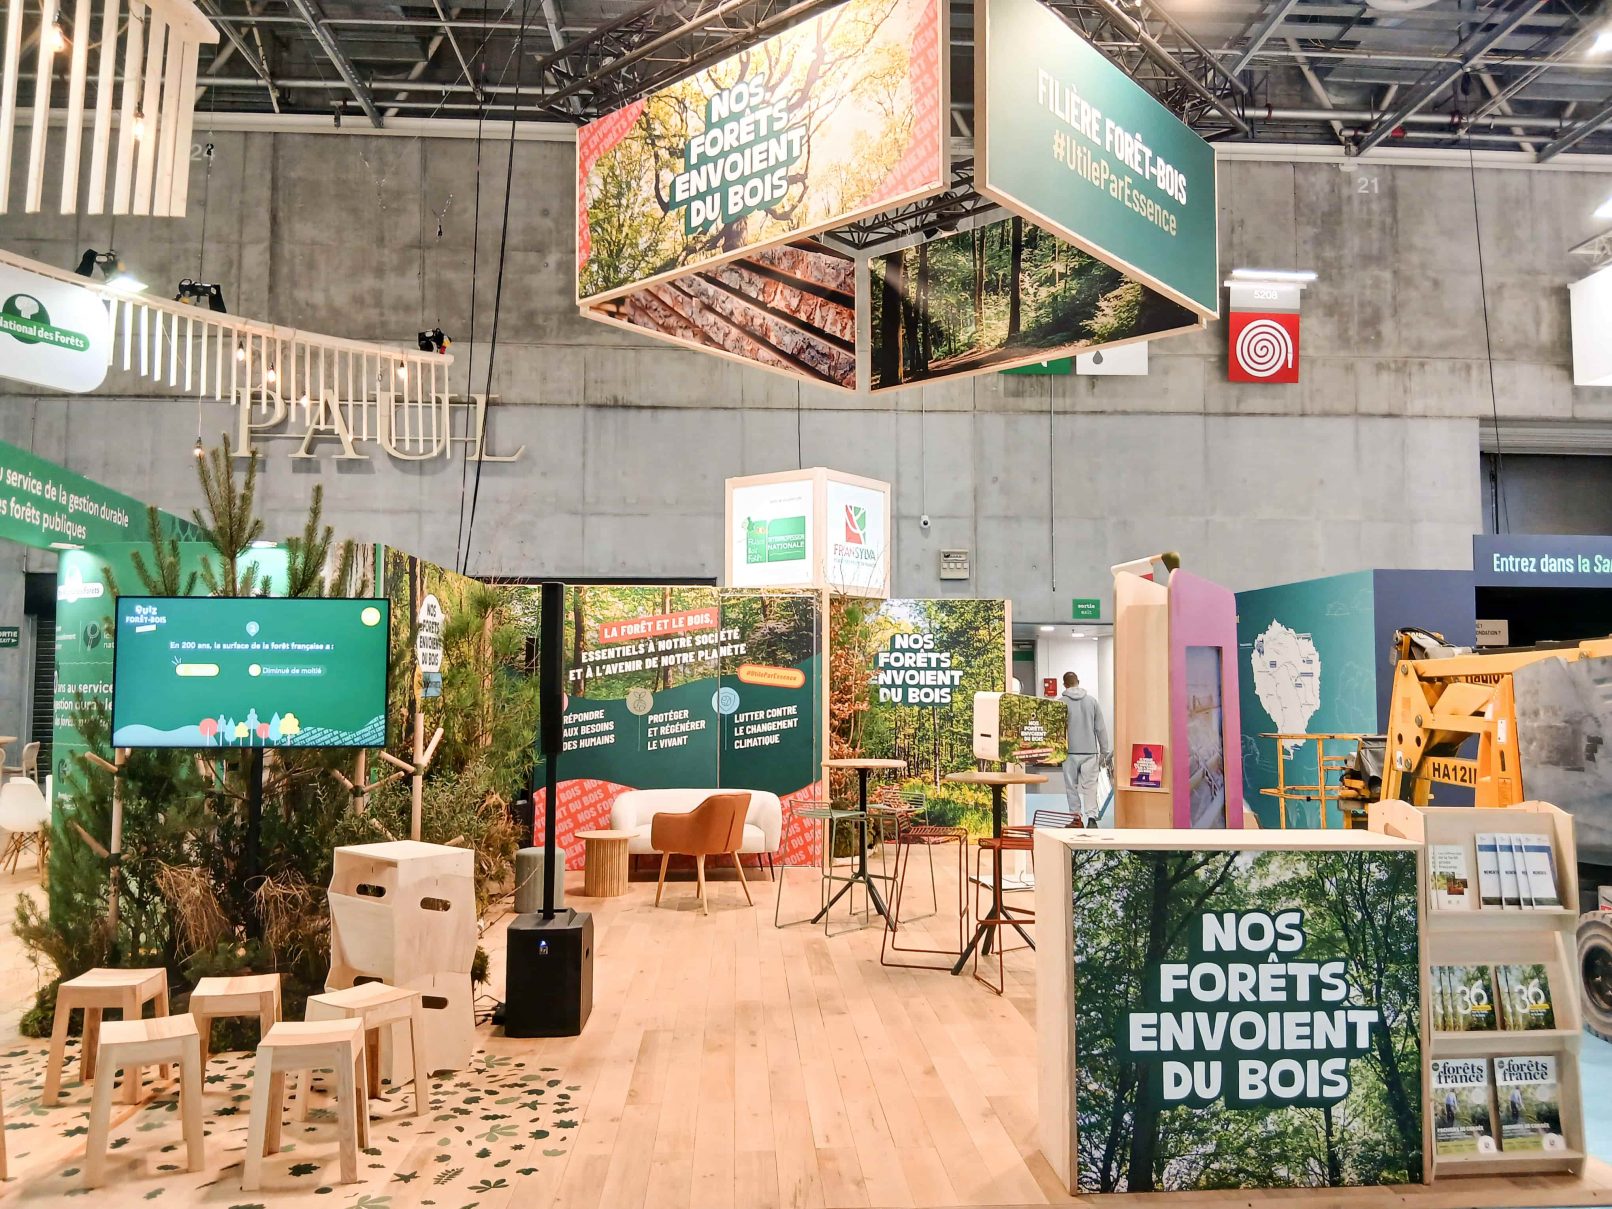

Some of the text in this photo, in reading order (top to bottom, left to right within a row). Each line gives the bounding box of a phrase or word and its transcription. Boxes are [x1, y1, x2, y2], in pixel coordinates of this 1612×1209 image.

[711, 75, 765, 124] NOS
[690, 104, 789, 165] FORÊTS
[1038, 67, 1187, 205] FILIÈRE FORÊT-BOIS
[676, 127, 807, 203] ENVOIENT
[1053, 129, 1177, 236] #UtileParEssence
[1357, 178, 1380, 195] 21
[691, 174, 789, 229] DU BOIS
[37, 327, 54, 341] des
[55, 331, 85, 348] Forêts
[230, 387, 526, 462] PAUL
[6, 468, 42, 495] service
[45, 479, 57, 501] de
[59, 484, 67, 505] la
[68, 494, 99, 517] gestion
[100, 502, 129, 528] durable
[10, 496, 41, 525] forêts
[42, 511, 87, 541] publiques
[833, 543, 876, 561] FRANSYLVA
[1493, 553, 1537, 573] Entrez
[1541, 554, 1575, 573] dans
[1578, 554, 1590, 573] la
[427, 603, 437, 618] NOS
[604, 612, 714, 639] LA FORÊT ET LE BOIS,
[170, 641, 180, 650] En
[181, 641, 196, 650] 200
[197, 642, 212, 651] ans,
[213, 641, 220, 650] la
[222, 641, 249, 651] surface
[250, 641, 260, 650] de
[262, 641, 269, 650] la
[270, 641, 290, 650] forêt
[290, 642, 324, 652] française
[581, 628, 740, 663] ESSENTIELS À NOTRE SOCIÉTÉ
[894, 633, 935, 650] NOS
[422, 652, 439, 667] DU BOIS
[569, 669, 584, 681] ET
[585, 666, 595, 679] À
[645, 657, 658, 669] DE
[660, 651, 696, 667] NOTRE
[697, 643, 747, 661] PLANÈTE
[878, 648, 952, 668] FORÊTS
[262, 666, 322, 675] Diminué de moitié
[67, 683, 77, 693] au
[879, 687, 952, 704] DU BOIS
[563, 709, 605, 725] RÉPONDRE
[648, 709, 690, 724] PROTÉGER
[734, 705, 798, 723] LUTTER CONTRE
[563, 721, 615, 738] AUX BESOINS
[647, 719, 706, 737] ET RÉGÉNÉRER
[734, 718, 799, 737] LE CHANGEMENT
[563, 734, 615, 752] DES HUMAINS
[647, 735, 689, 751] LE VIVANT
[734, 734, 780, 749] CLIMATIQUE
[1201, 911, 1304, 952] NOS
[1159, 952, 1349, 1002] FORÊTS
[1456, 979, 1488, 1015] 36
[1514, 978, 1546, 1014] 36
[1129, 1009, 1379, 1052] ENVOIENT
[1442, 1061, 1485, 1075] forêts
[1503, 1068, 1549, 1081] france
[1507, 1059, 1548, 1072] forêts
[1162, 1057, 1349, 1100] DU BOIS
[1437, 1069, 1484, 1084] france
